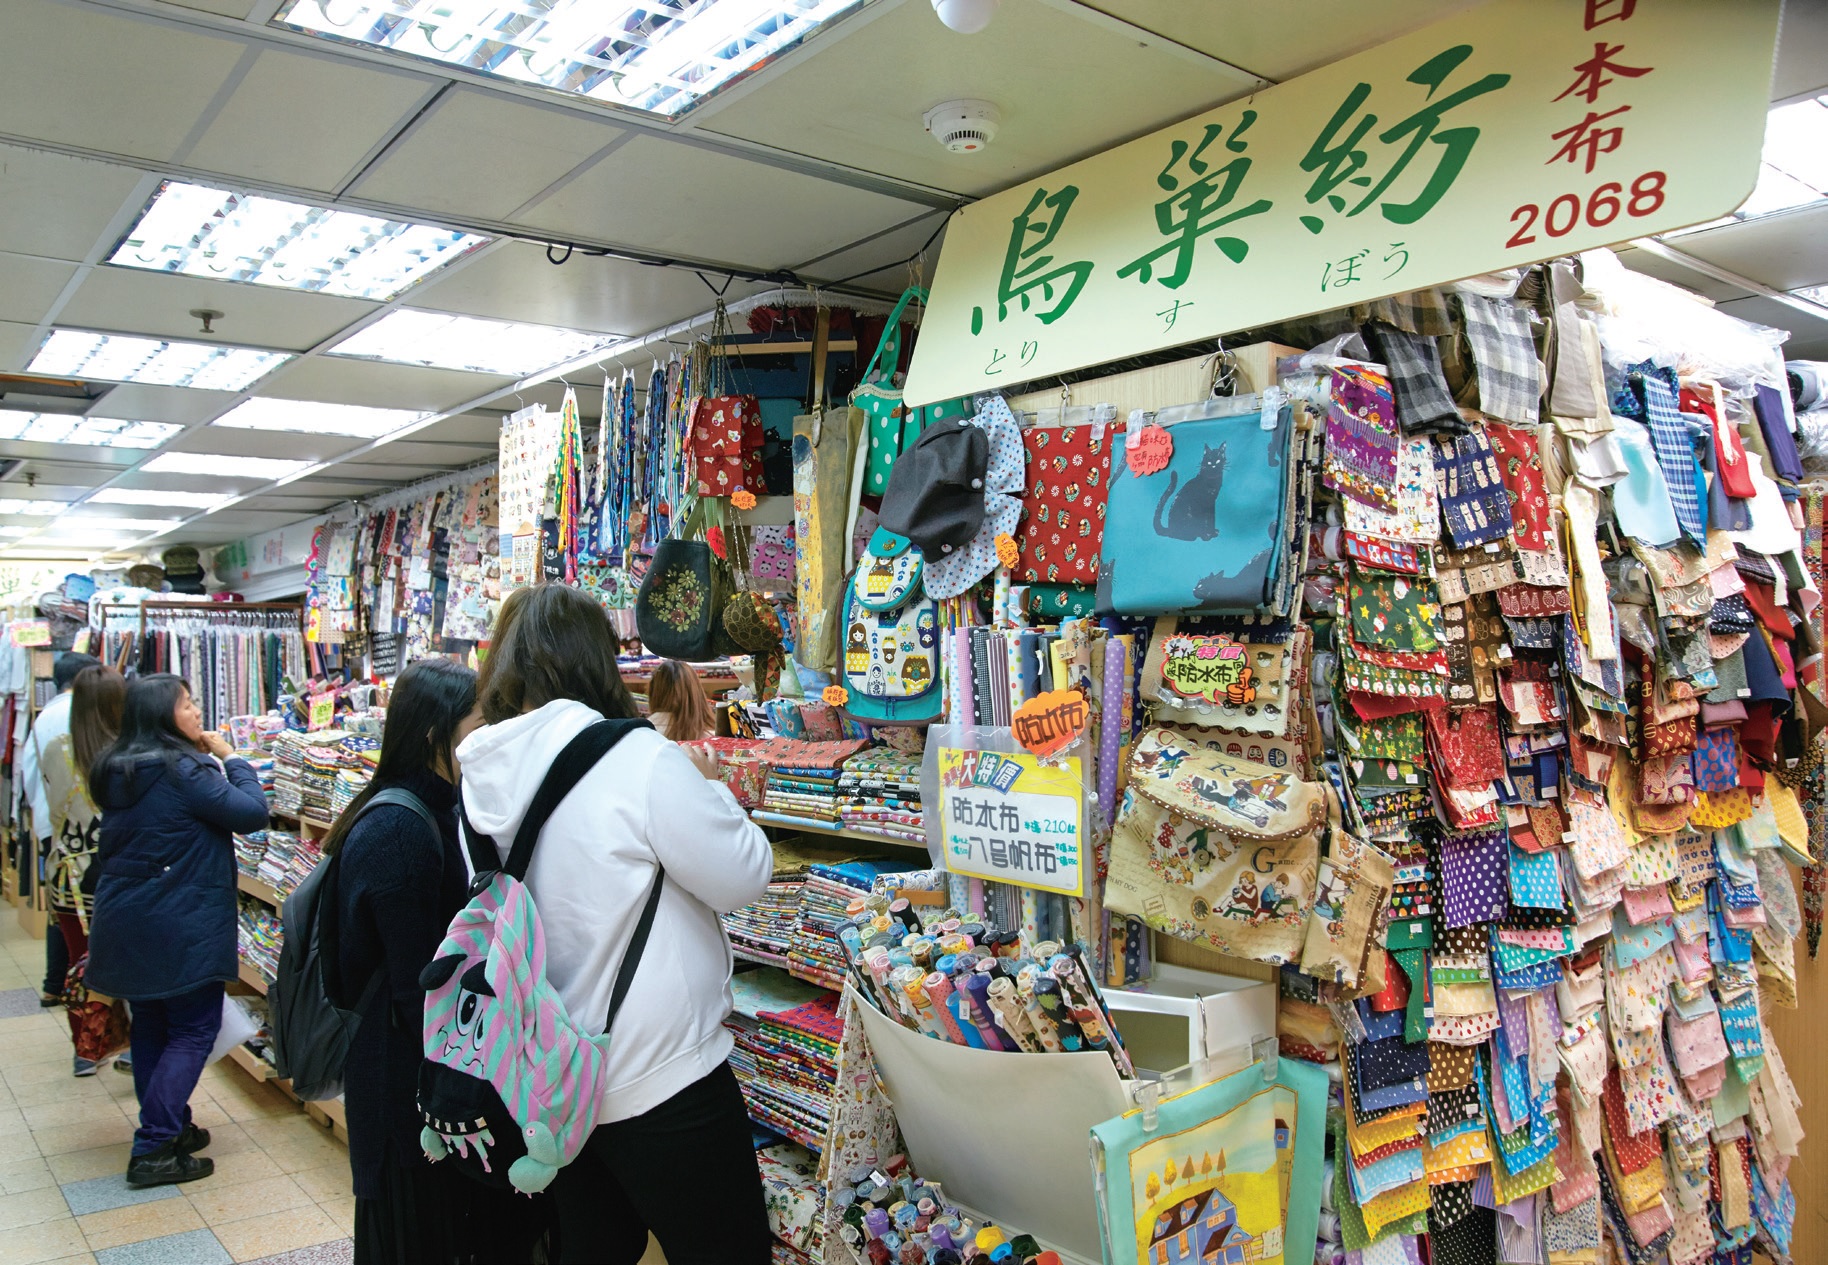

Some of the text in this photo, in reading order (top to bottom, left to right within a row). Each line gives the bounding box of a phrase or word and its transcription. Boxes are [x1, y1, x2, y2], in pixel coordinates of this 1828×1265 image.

[971, 44, 1511, 336] 鳥巢紡
[1505, 171, 1667, 248] 2068
[984, 242, 1409, 376] とり す ぼう
[1176, 661, 1233, 685] 防水布
[1014, 701, 1084, 749] 防水布
[951, 796, 1020, 834] 防水布
[1123, 882, 1138, 893] DOG
